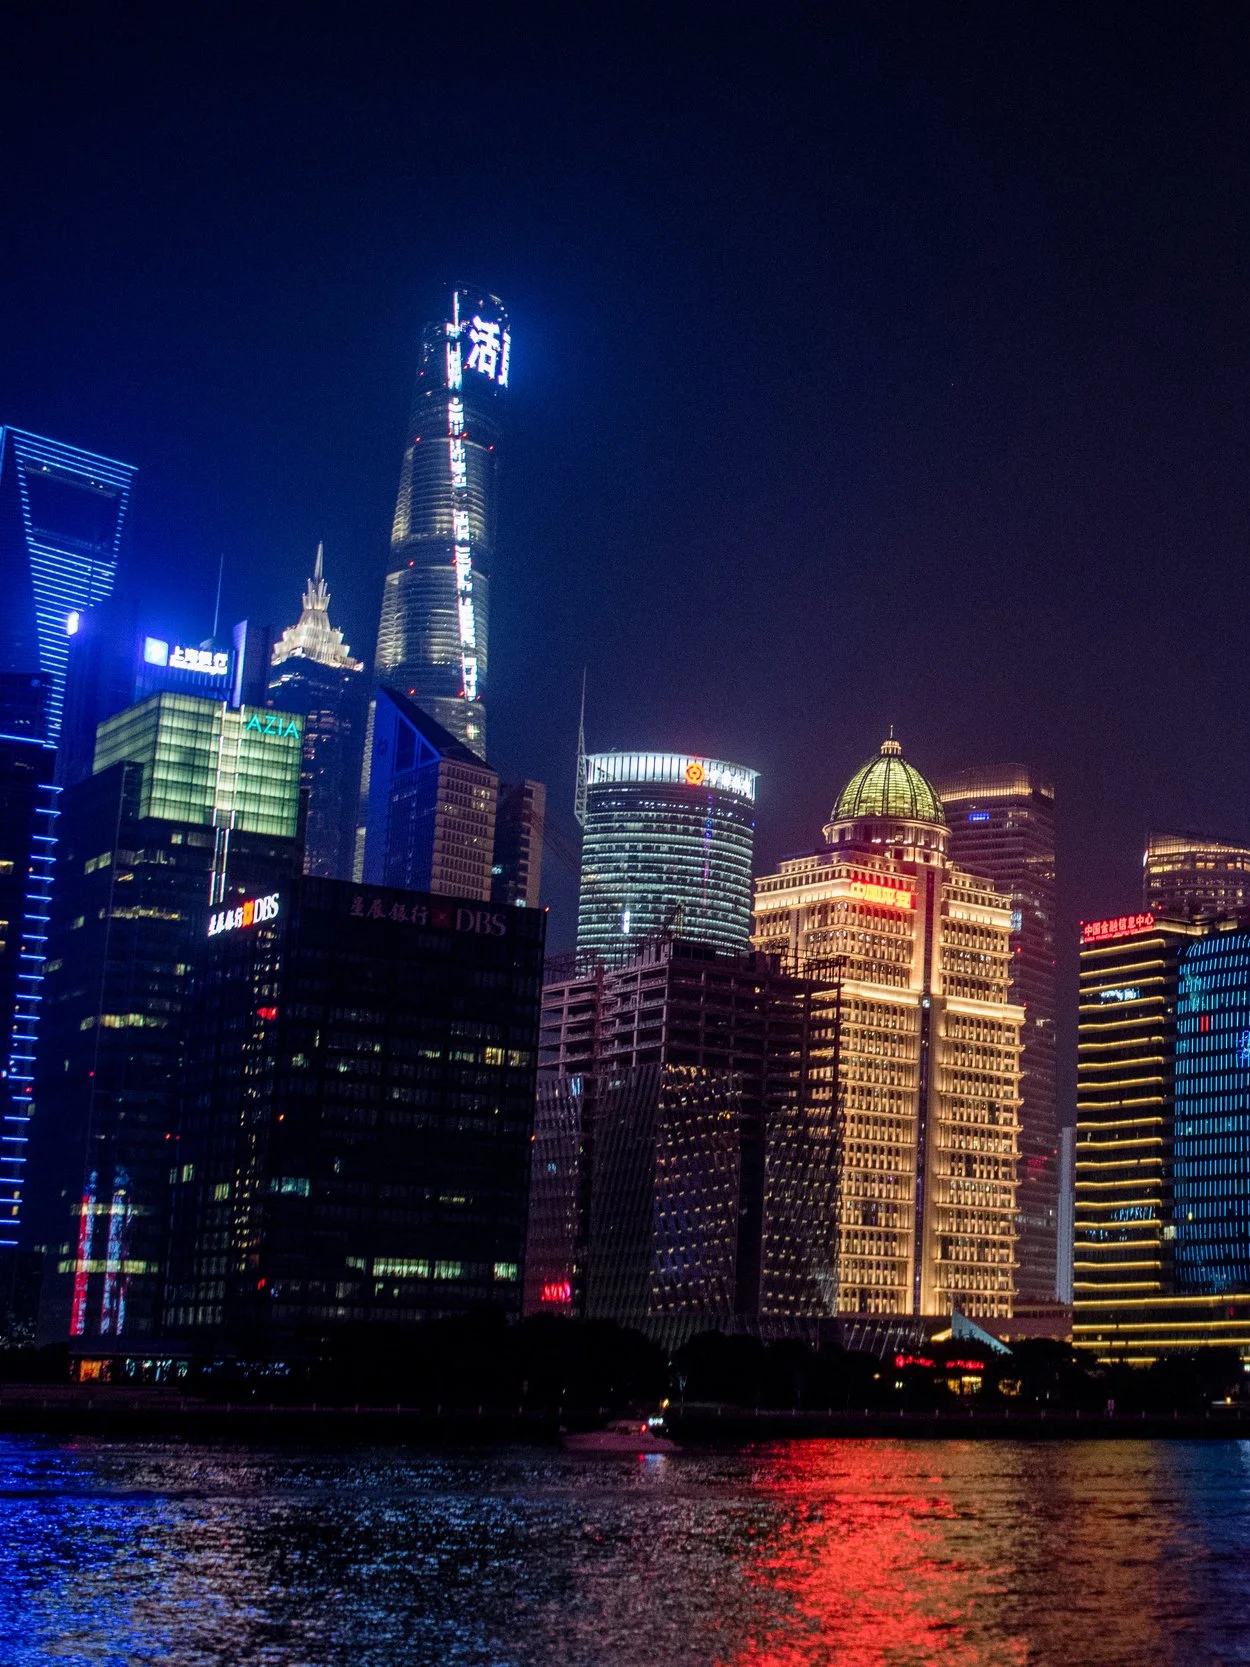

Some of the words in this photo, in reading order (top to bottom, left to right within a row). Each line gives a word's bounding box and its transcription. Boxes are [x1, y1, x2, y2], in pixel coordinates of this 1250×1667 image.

[246, 713, 299, 740] AZIA
[253, 892, 279, 924] DBS
[455, 908, 507, 937] DBS
[1084, 912, 1154, 937] 中国金融信息中心
